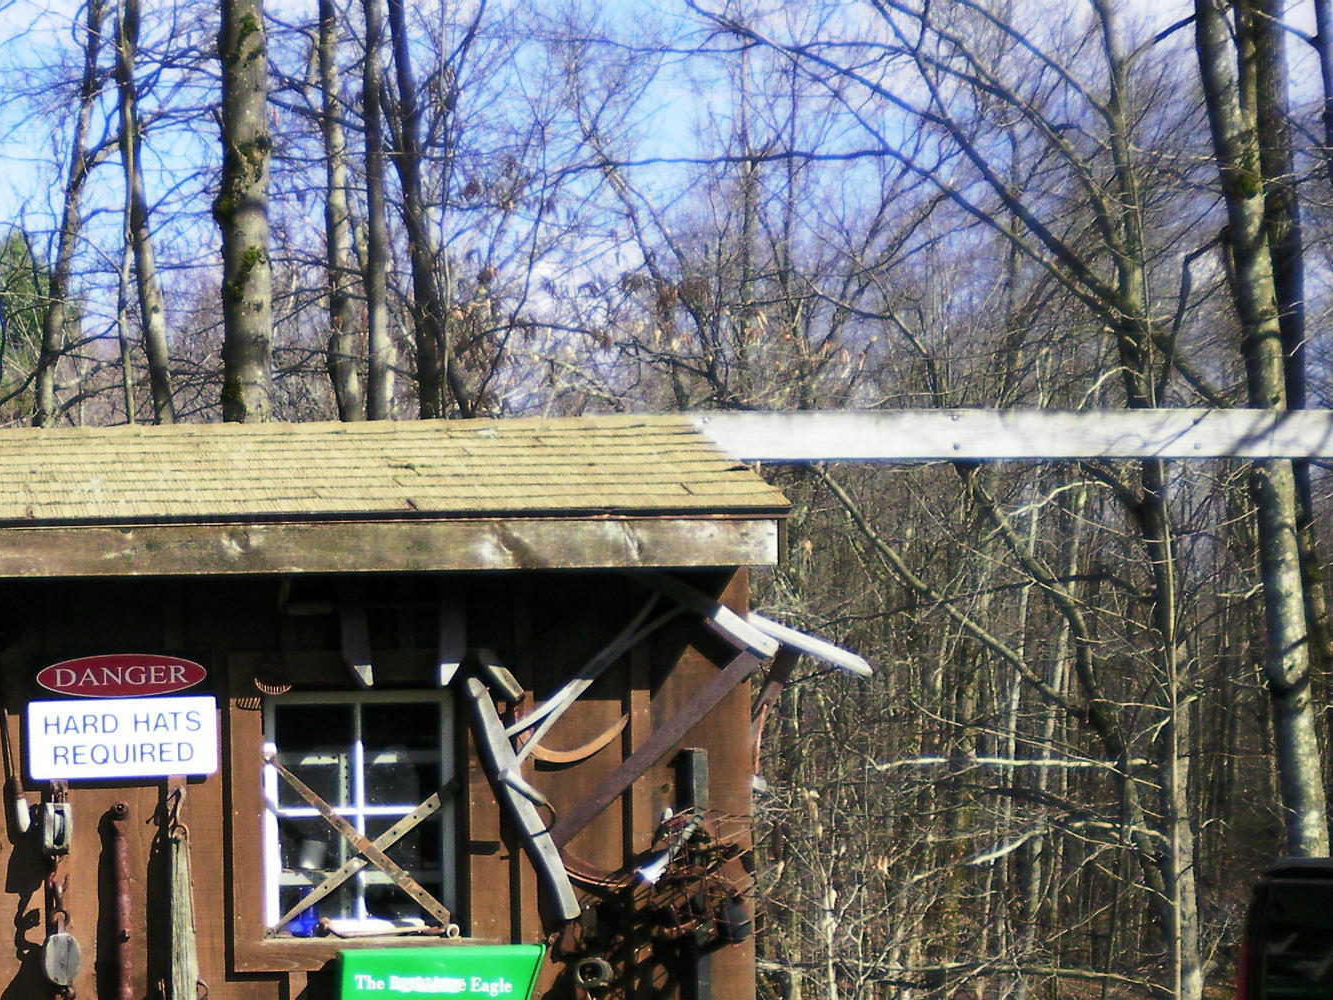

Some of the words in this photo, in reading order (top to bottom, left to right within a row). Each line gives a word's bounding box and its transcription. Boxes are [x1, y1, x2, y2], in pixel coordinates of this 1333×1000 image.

[55, 665, 189, 687] DANGER
[44, 713, 119, 735] HARD
[133, 710, 202, 732] HATS
[52, 742, 195, 765] REQUIRED
[354, 974, 386, 990] The
[470, 977, 513, 997] Eagle
